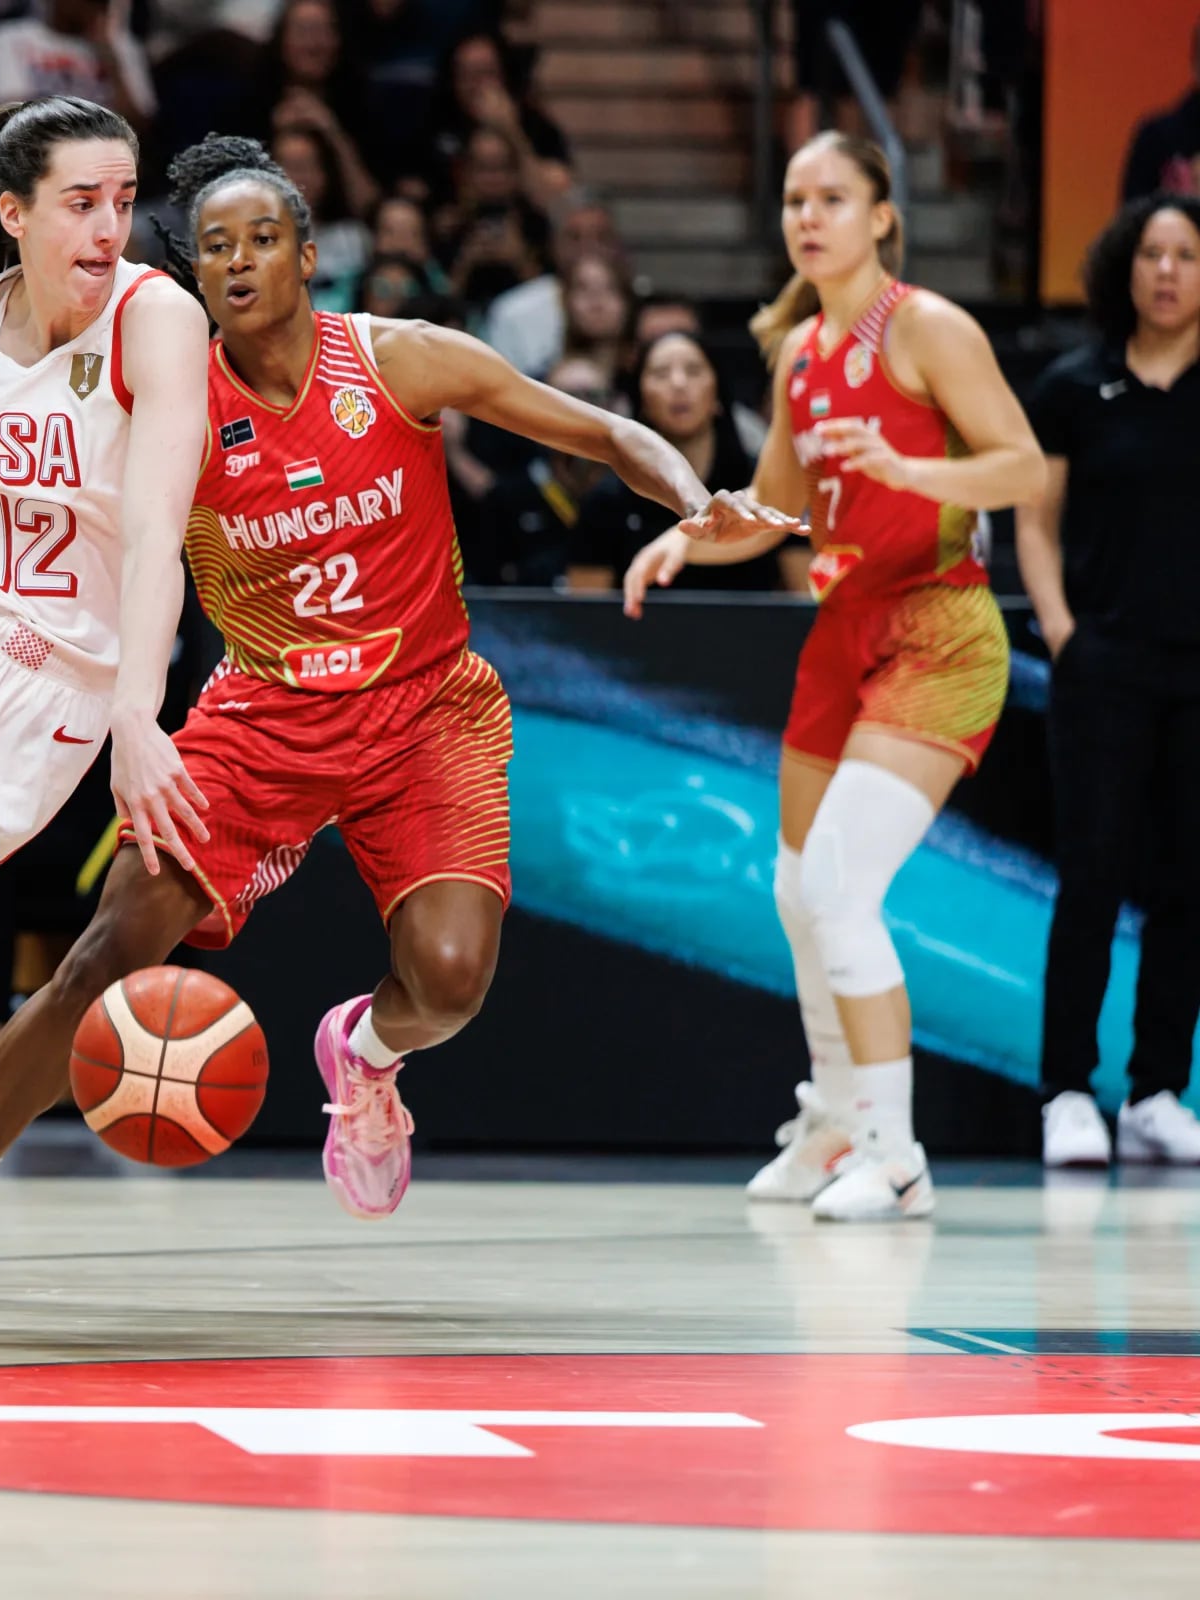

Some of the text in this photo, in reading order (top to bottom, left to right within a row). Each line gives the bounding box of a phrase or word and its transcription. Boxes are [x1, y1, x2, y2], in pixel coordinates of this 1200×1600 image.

[217, 467, 403, 550] HUNGARY
[818, 477, 841, 531] 7
[288, 552, 364, 618] 22
[300, 647, 364, 679] MOL
